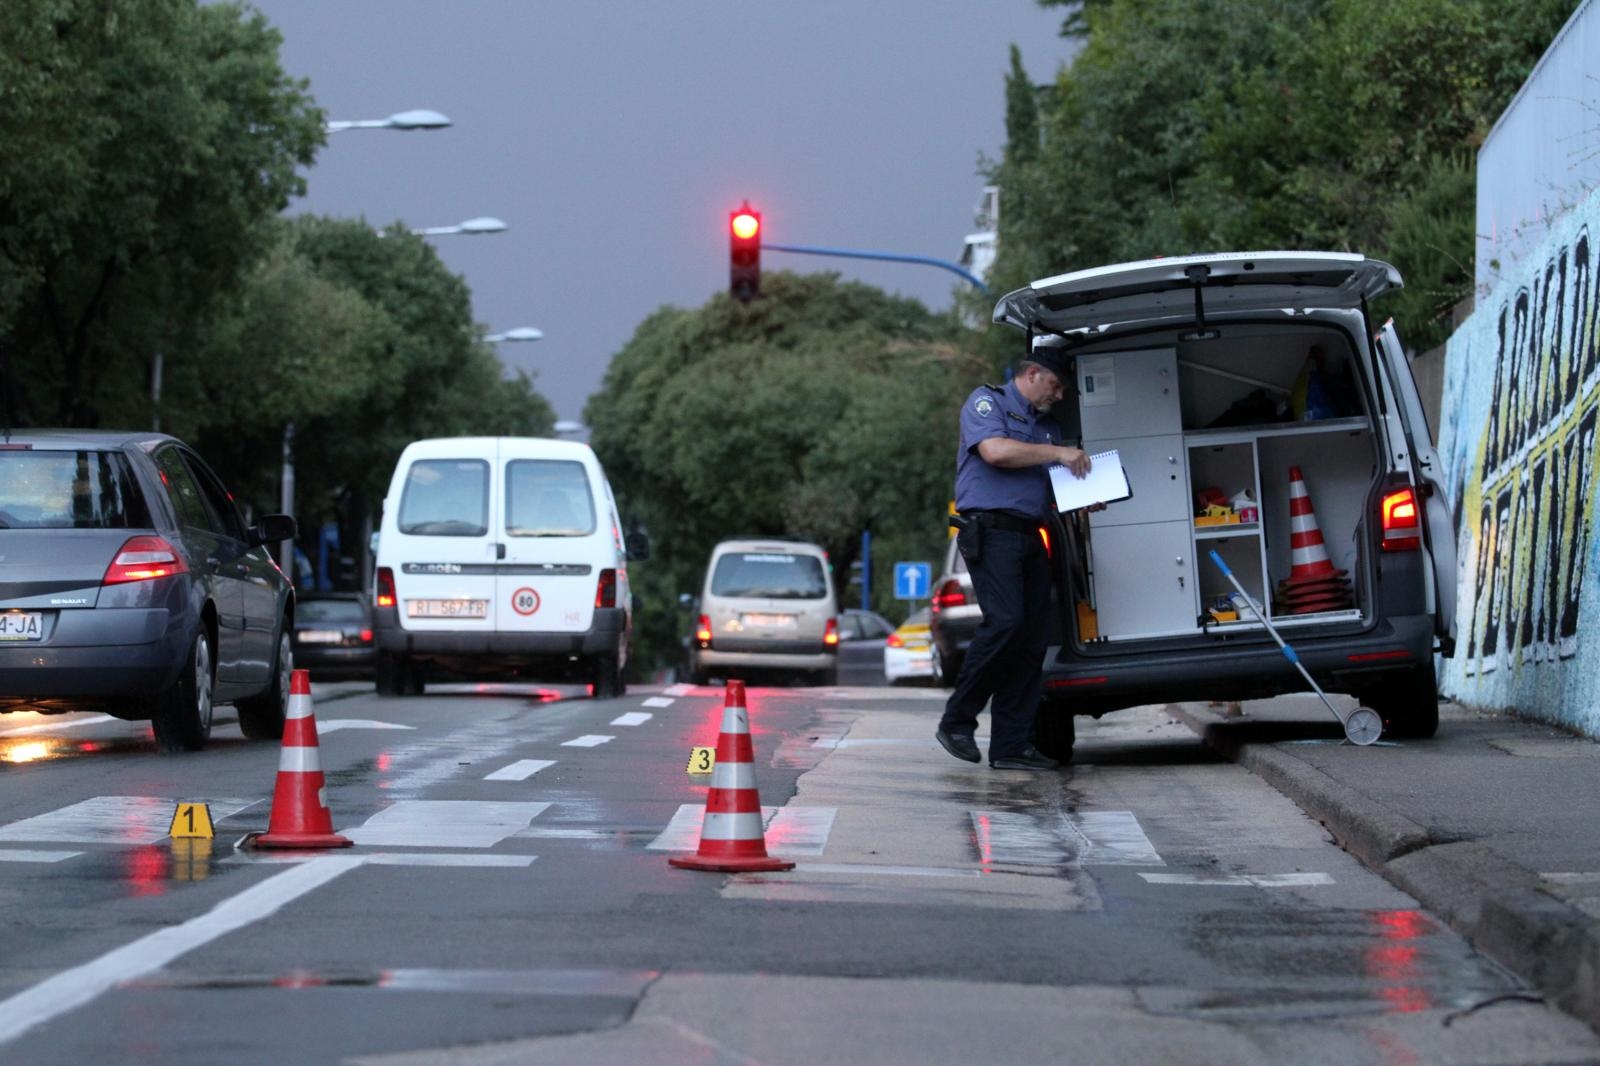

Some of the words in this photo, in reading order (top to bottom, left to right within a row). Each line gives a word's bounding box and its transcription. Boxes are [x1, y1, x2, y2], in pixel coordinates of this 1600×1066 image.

[519, 596, 534, 608] 80
[698, 749, 710, 771] 3
[183, 806, 194, 833] 1
